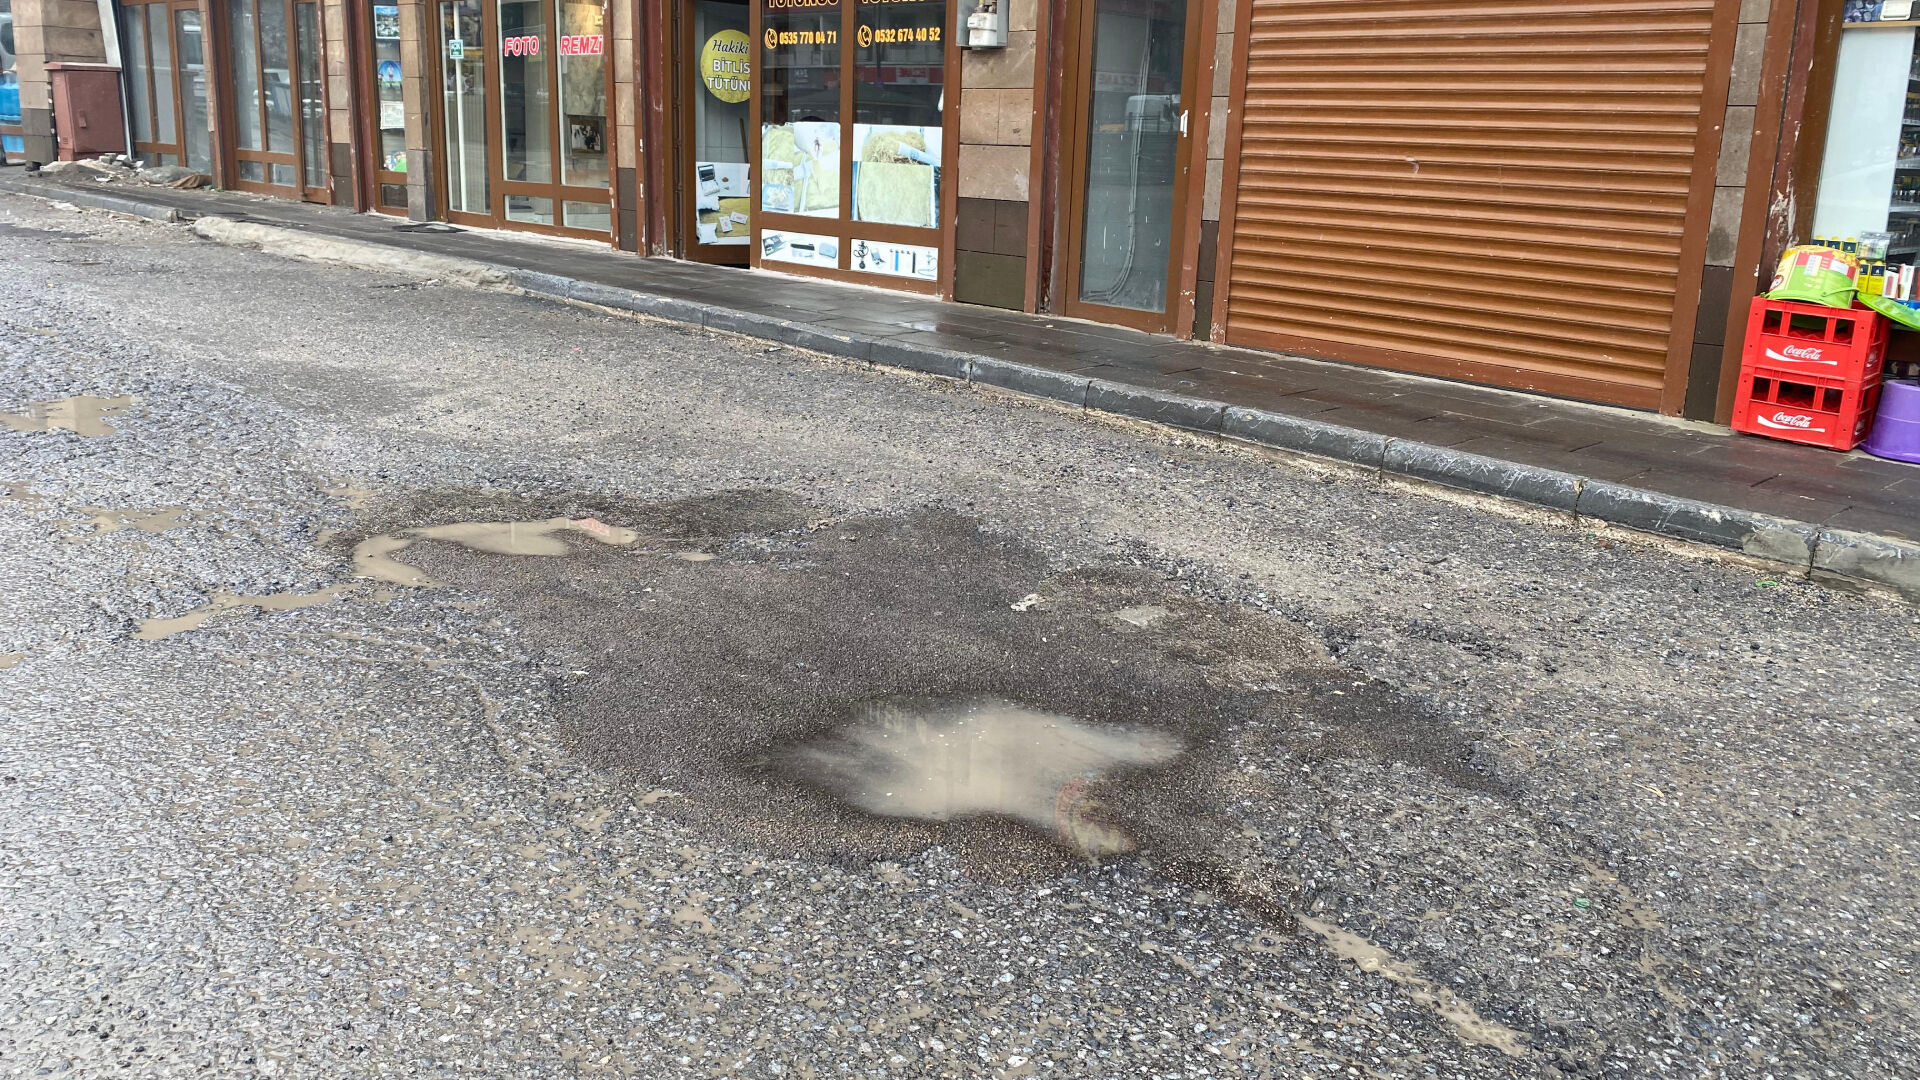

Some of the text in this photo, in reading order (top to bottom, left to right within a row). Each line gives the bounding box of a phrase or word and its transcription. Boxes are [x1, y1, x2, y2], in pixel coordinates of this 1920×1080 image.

[779, 32, 797, 44] 0535
[800, 31, 813, 44] 770
[827, 31, 836, 43] 71
[875, 27, 941, 43] 0532 674 40 52
[504, 35, 540, 57] FOTO
[712, 40, 749, 54] Hakiki
[713, 57, 750, 74] BİTLİS
